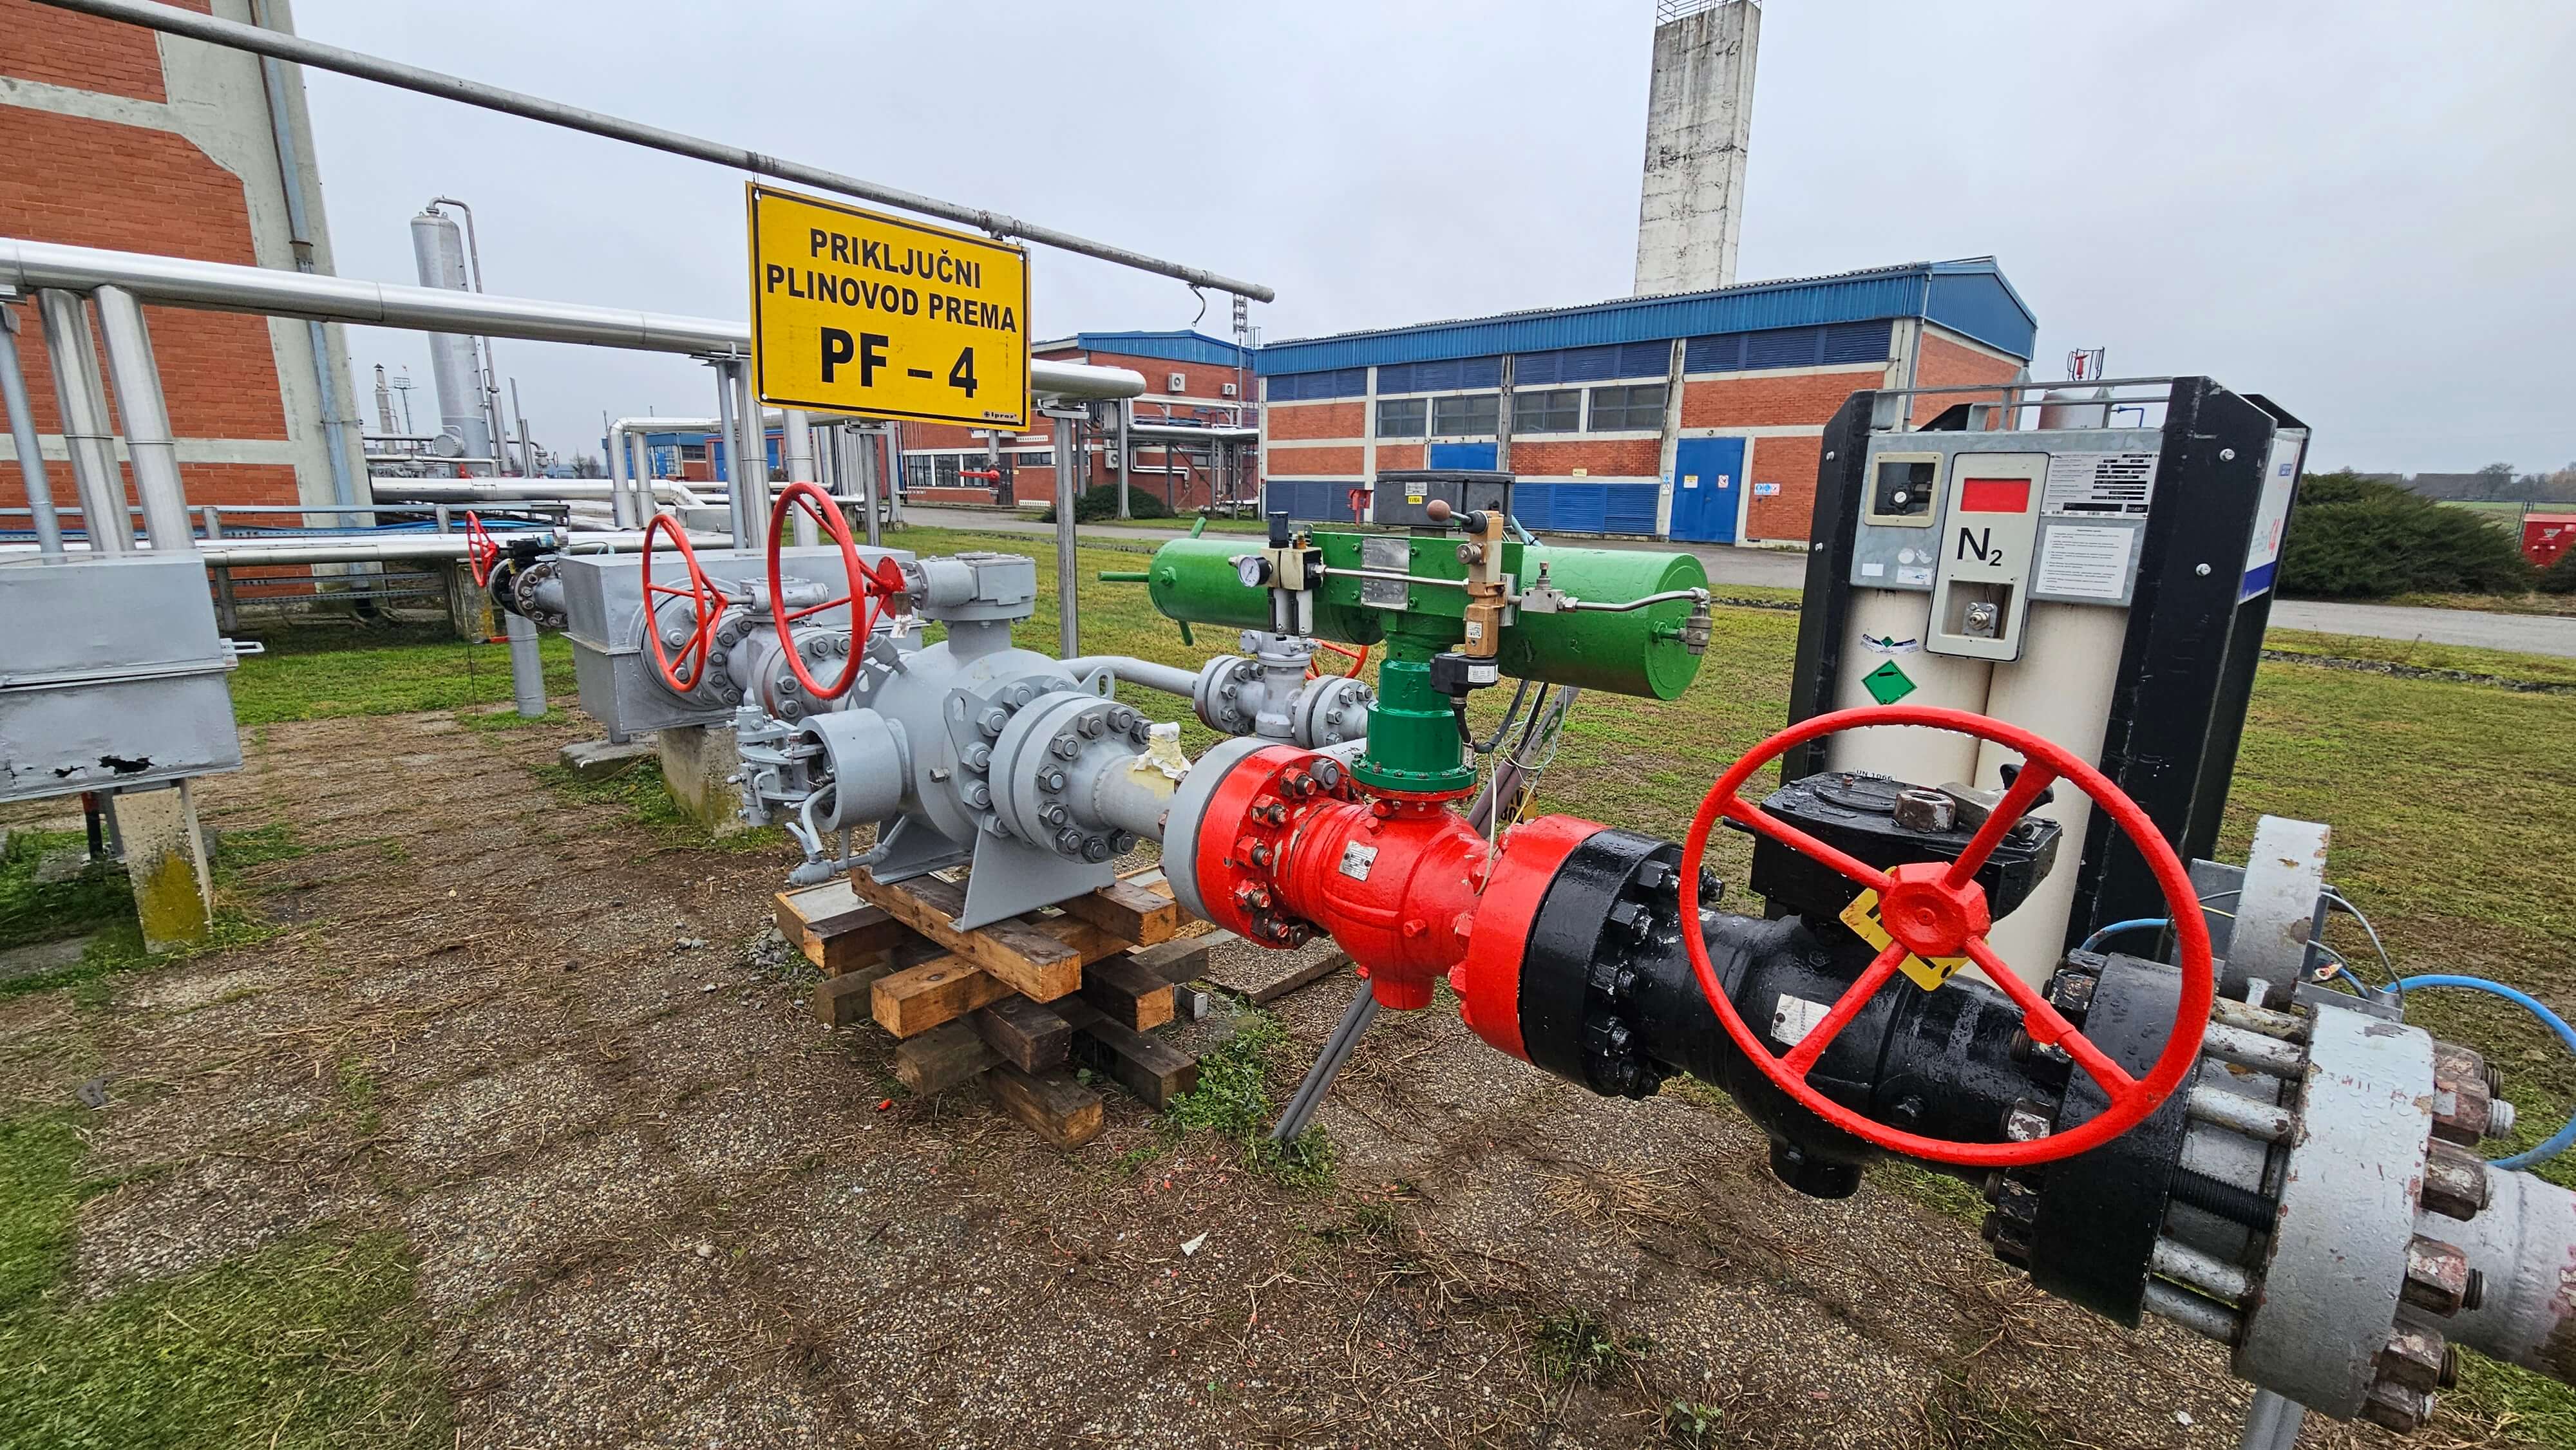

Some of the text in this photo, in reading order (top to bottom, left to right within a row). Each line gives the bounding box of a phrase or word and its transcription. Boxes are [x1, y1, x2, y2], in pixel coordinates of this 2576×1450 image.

[810, 228, 981, 288] PRIKLJUČNI
[766, 263, 1017, 333] PLINOVOD PREMA
[820, 326, 889, 388] PF
[949, 346, 978, 399] 4
